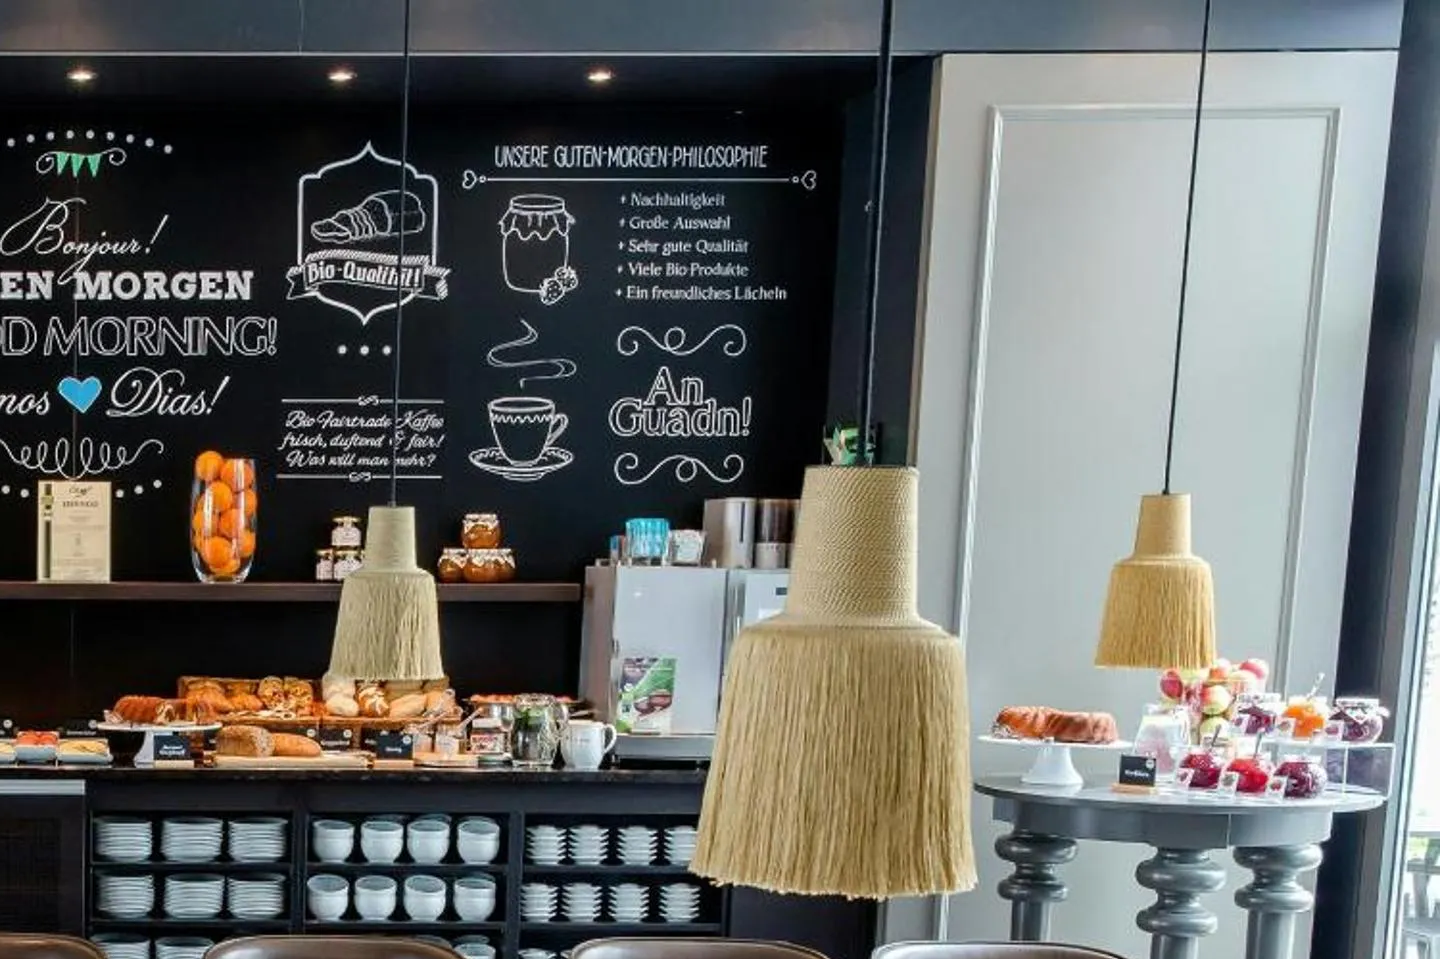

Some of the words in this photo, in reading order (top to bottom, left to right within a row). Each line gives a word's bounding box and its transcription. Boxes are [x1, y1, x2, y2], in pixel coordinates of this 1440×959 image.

[494, 145, 549, 168] UNSERE
[554, 145, 769, 168] GUTEN-MORGEN-PHILOSOPHIE
[630, 192, 726, 210] Nachhaltigkeit
[628, 215, 670, 230] Große
[674, 215, 731, 230] Auswahl
[628, 239, 659, 254] Sehr
[661, 241, 692, 256] gute
[696, 239, 749, 255] Qualität
[628, 262, 663, 277] Viele
[73, 269, 255, 301] MORGEN
[626, 285, 648, 300] Ein
[651, 285, 732, 300] freundliches
[734, 285, 788, 300] Lächeln
[44, 316, 278, 356] MORNING!
[106, 366, 231, 417] Dias!
[644, 366, 706, 407] An
[285, 410, 315, 429] Bio
[317, 410, 393, 429] Fairtrade
[395, 409, 445, 432] Kaffee
[608, 397, 753, 437] Guadn!
[277, 432, 328, 451] frisch,
[330, 432, 386, 452] duftend
[404, 433, 446, 452] fair!
[285, 450, 326, 468] Was
[328, 453, 356, 466] will
[357, 457, 389, 466] man
